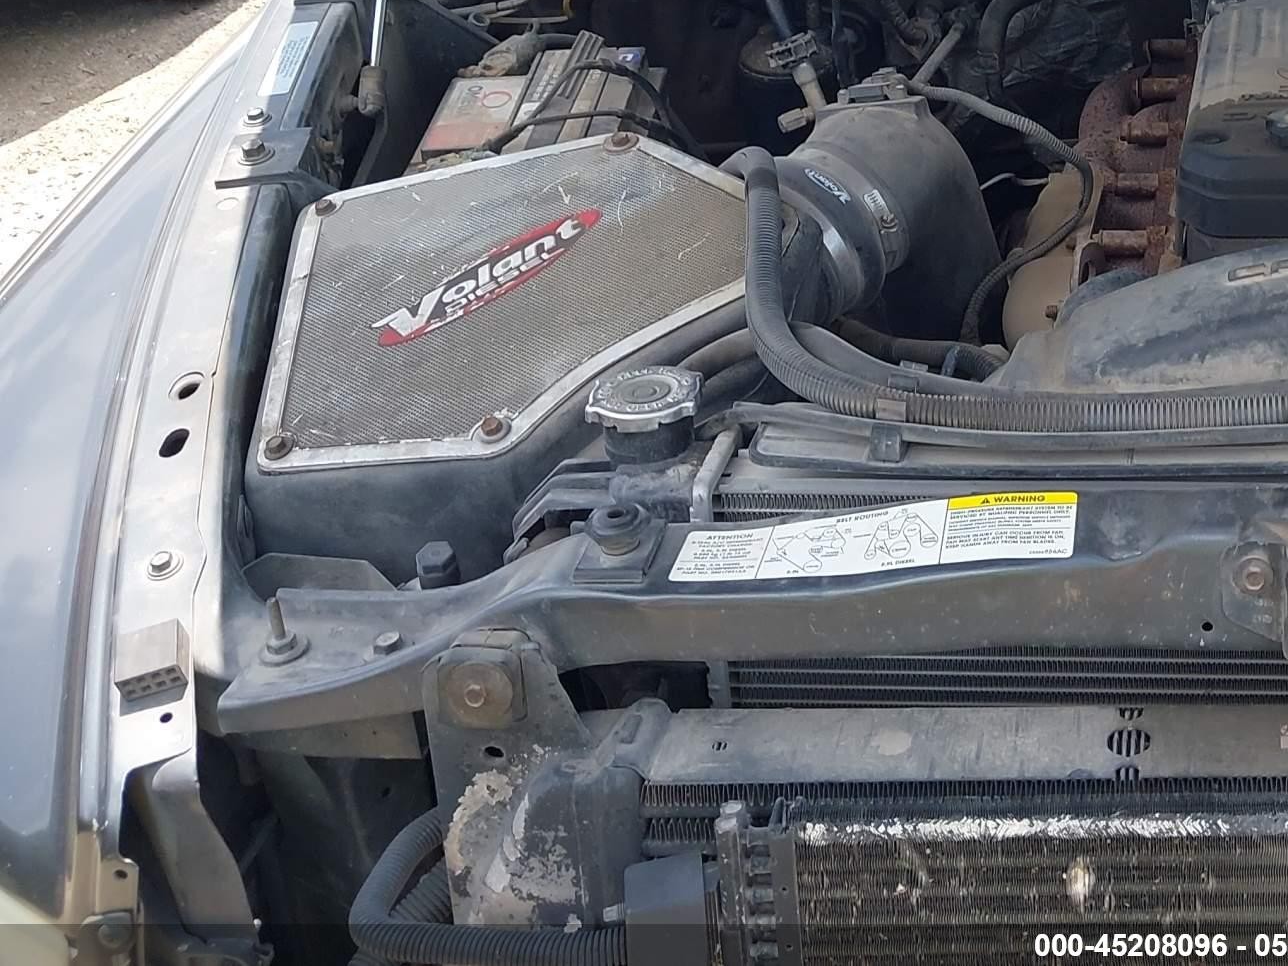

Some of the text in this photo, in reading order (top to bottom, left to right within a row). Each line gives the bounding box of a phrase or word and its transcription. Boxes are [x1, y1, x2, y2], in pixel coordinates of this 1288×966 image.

[805, 168, 852, 205] Volant
[370, 217, 585, 338] Volant
[993, 494, 1046, 504] WARNING
[854, 510, 889, 522] ROUTING
[705, 532, 754, 541] ATTENTION
